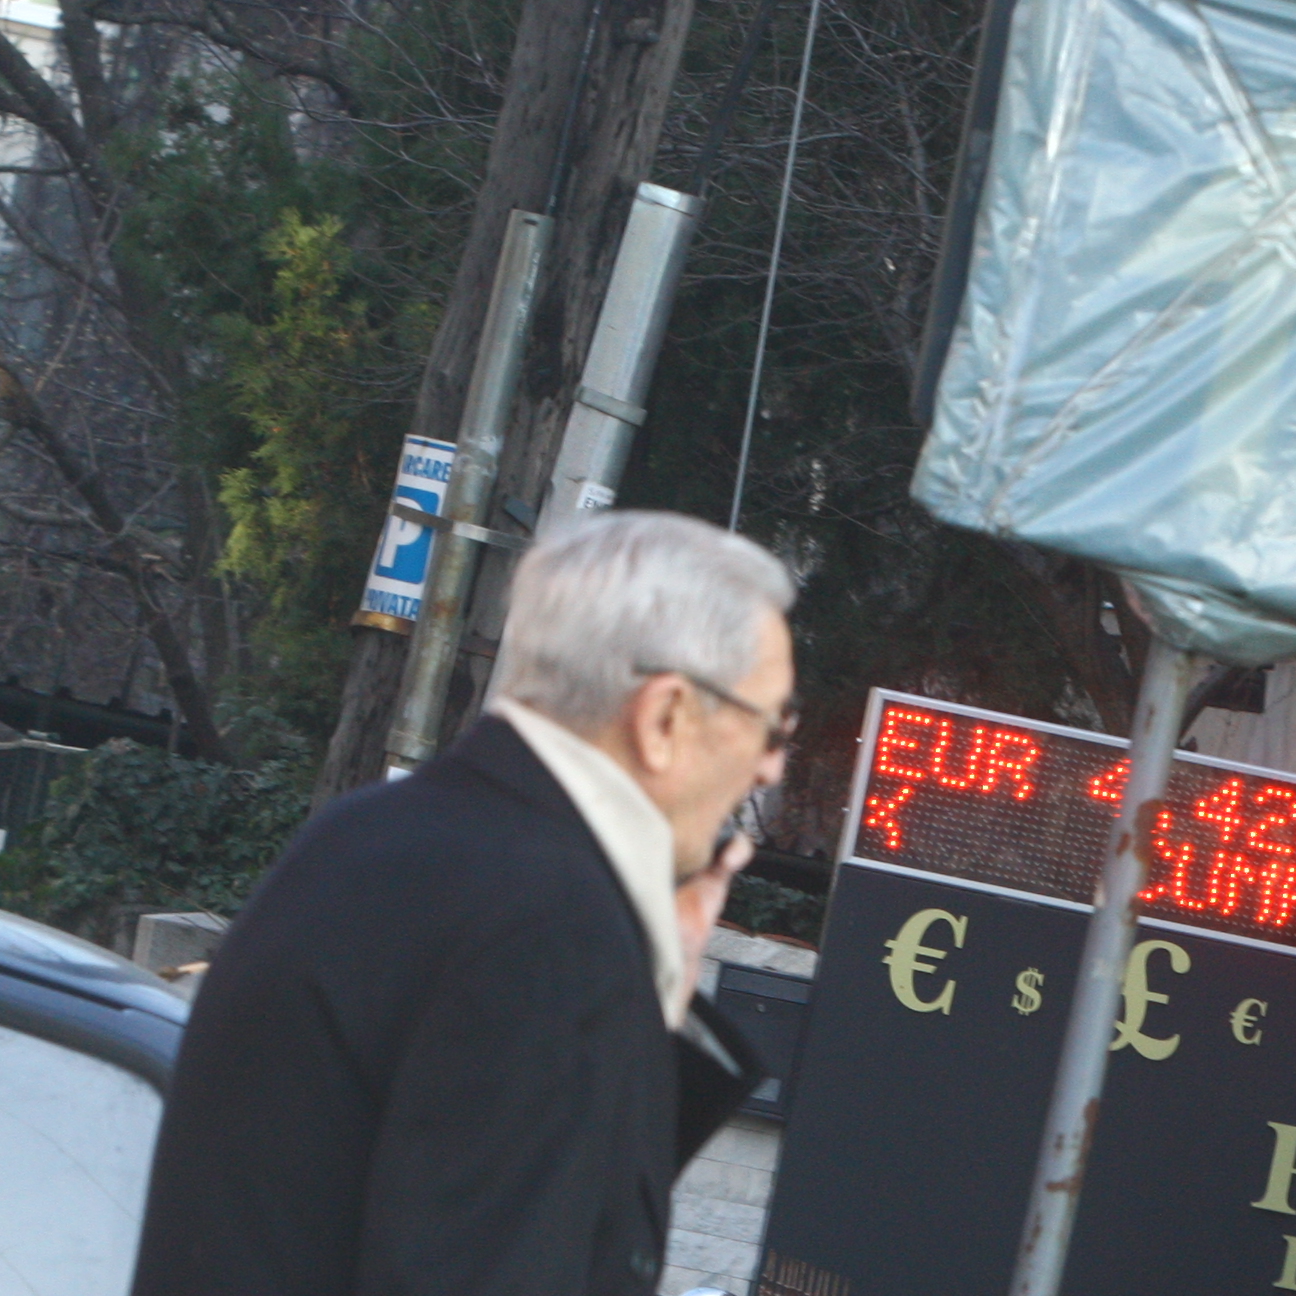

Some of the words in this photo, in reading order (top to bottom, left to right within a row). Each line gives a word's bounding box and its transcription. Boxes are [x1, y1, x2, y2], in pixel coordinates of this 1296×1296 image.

[379, 497, 424, 568] P
[876, 706, 1040, 801] EUR
[883, 909, 968, 1015] €
[1012, 967, 1044, 1015] $
[1108, 940, 1191, 1061] £
[1229, 998, 1267, 1044] €
